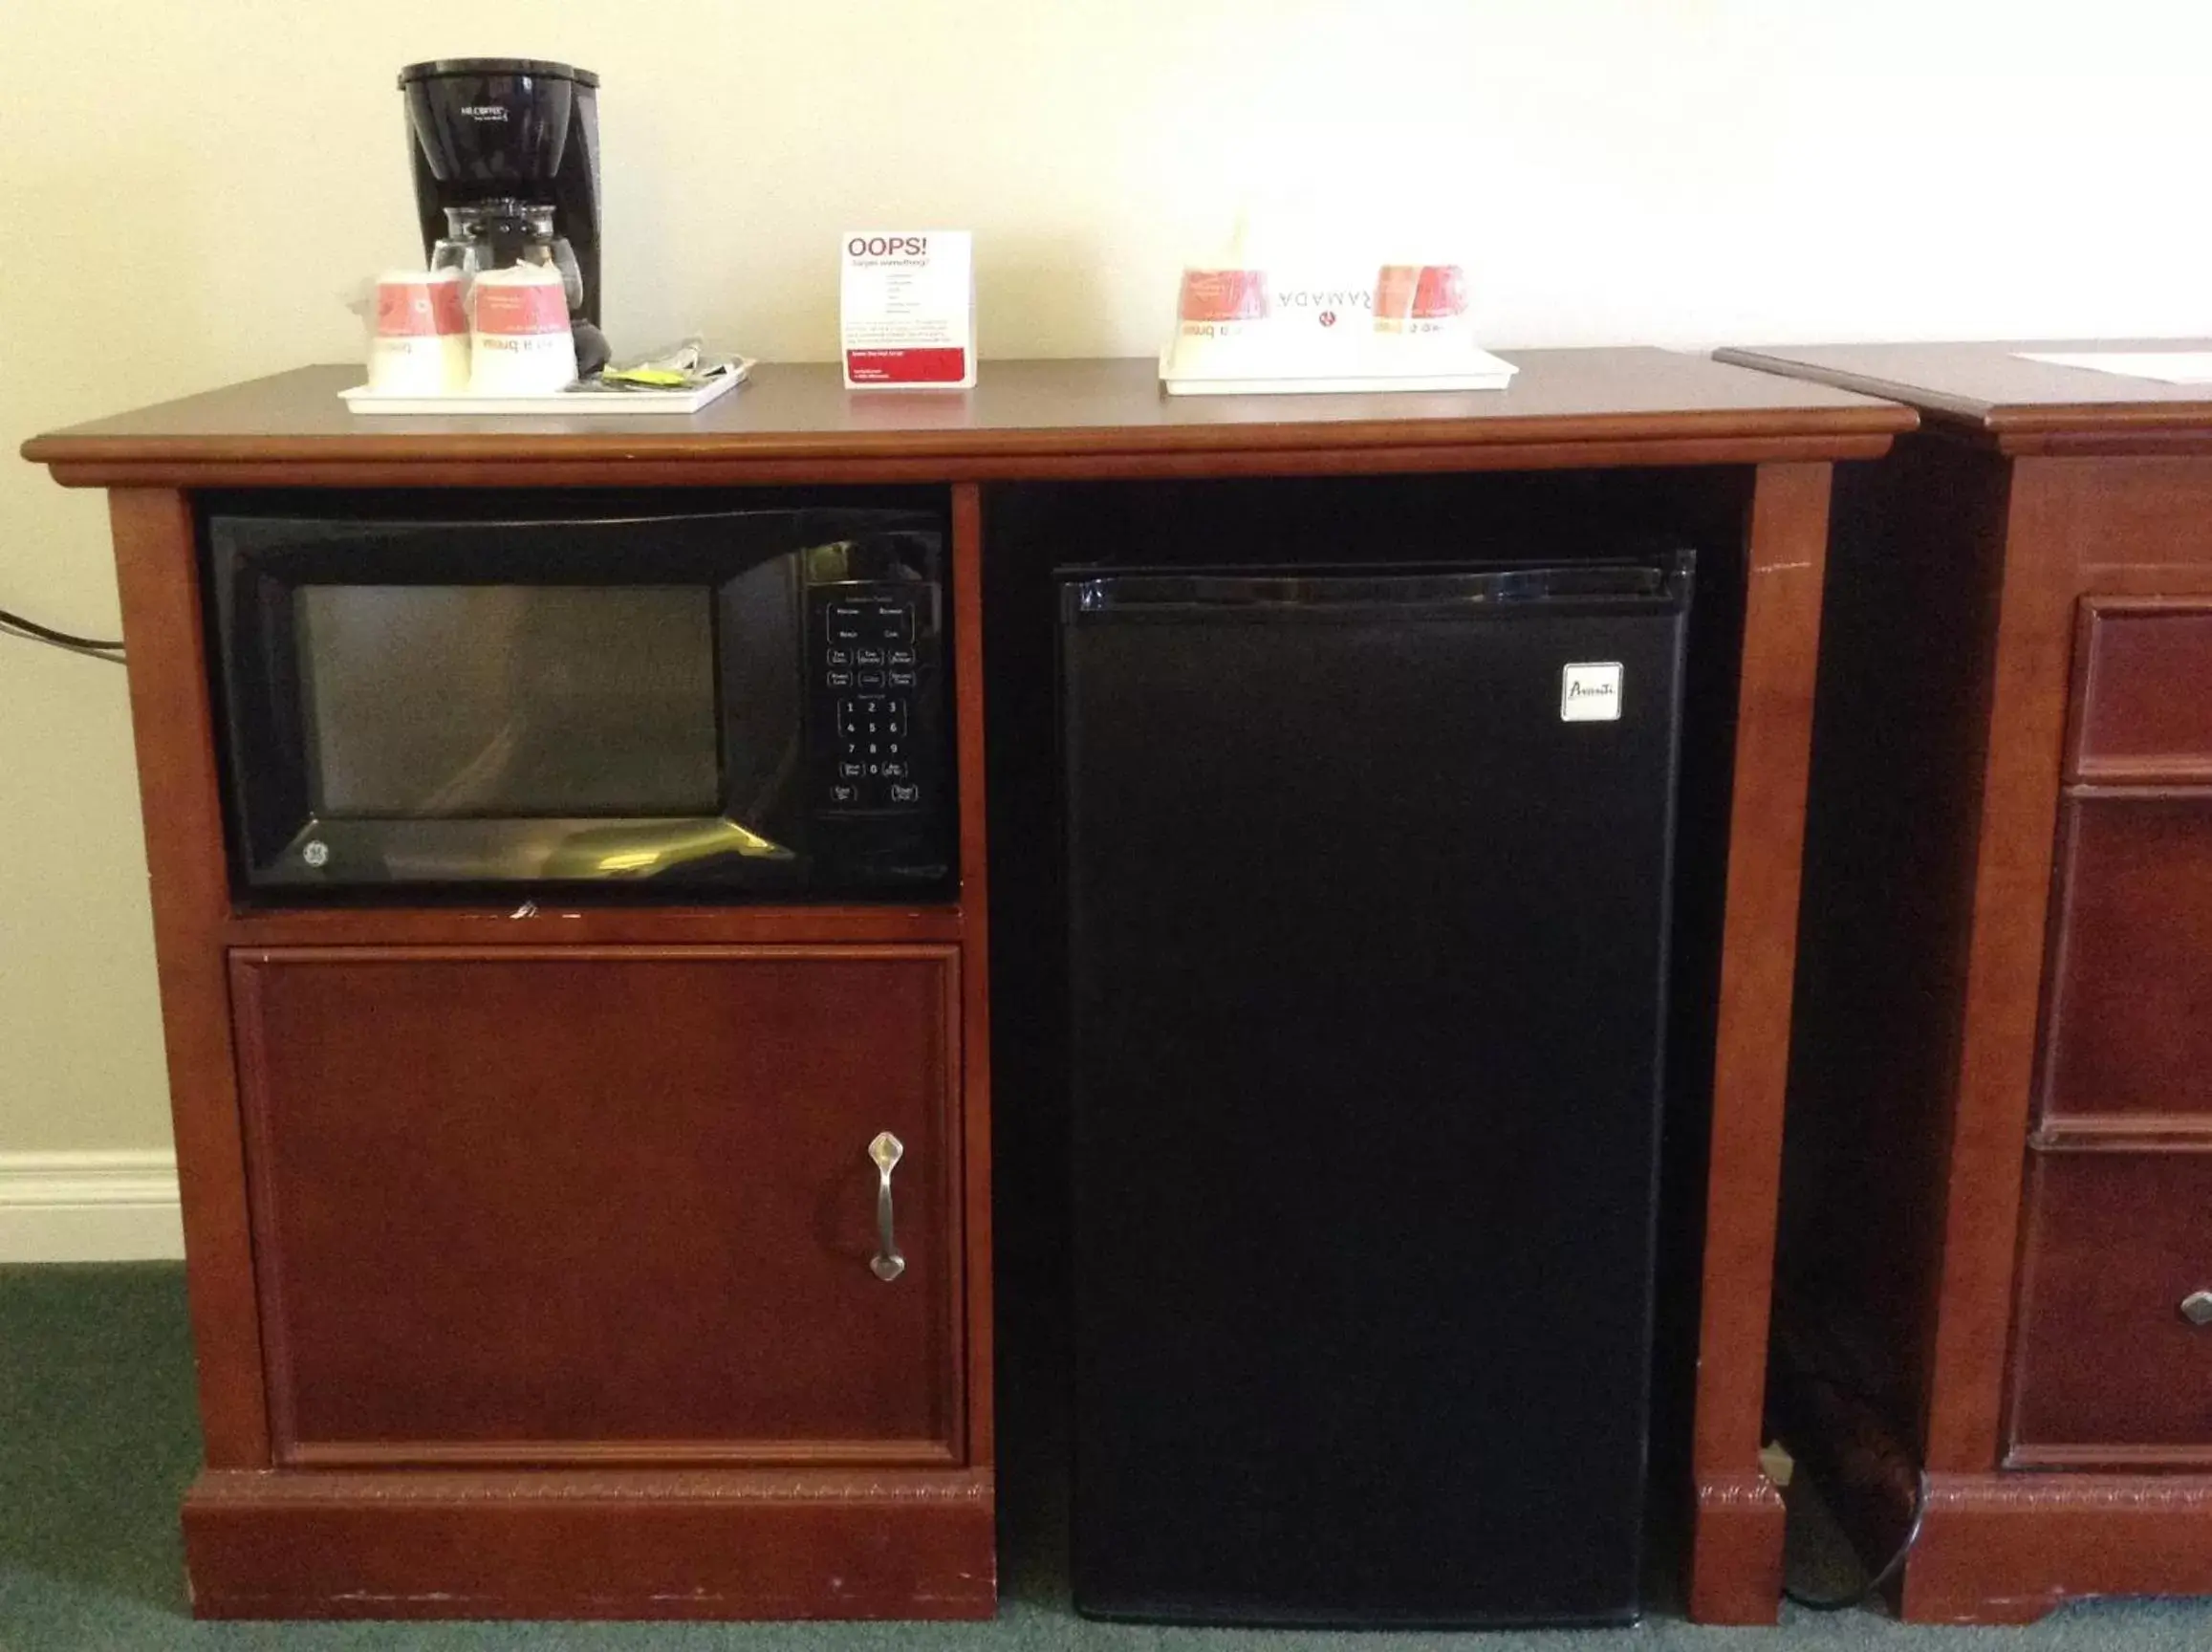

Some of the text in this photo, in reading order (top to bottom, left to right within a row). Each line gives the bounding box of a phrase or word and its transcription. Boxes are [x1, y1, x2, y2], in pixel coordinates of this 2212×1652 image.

[848, 237, 927, 256] OOPS!
[847, 701, 854, 712] 1
[868, 702, 877, 712] 2
[889, 701, 897, 713] 3
[847, 724, 855, 732] 4
[869, 723, 877, 732] 5
[890, 723, 898, 732] 6
[849, 744, 856, 753] 7
[869, 743, 877, 753] 8
[890, 744, 899, 753] 9
[870, 764, 878, 773] 0
